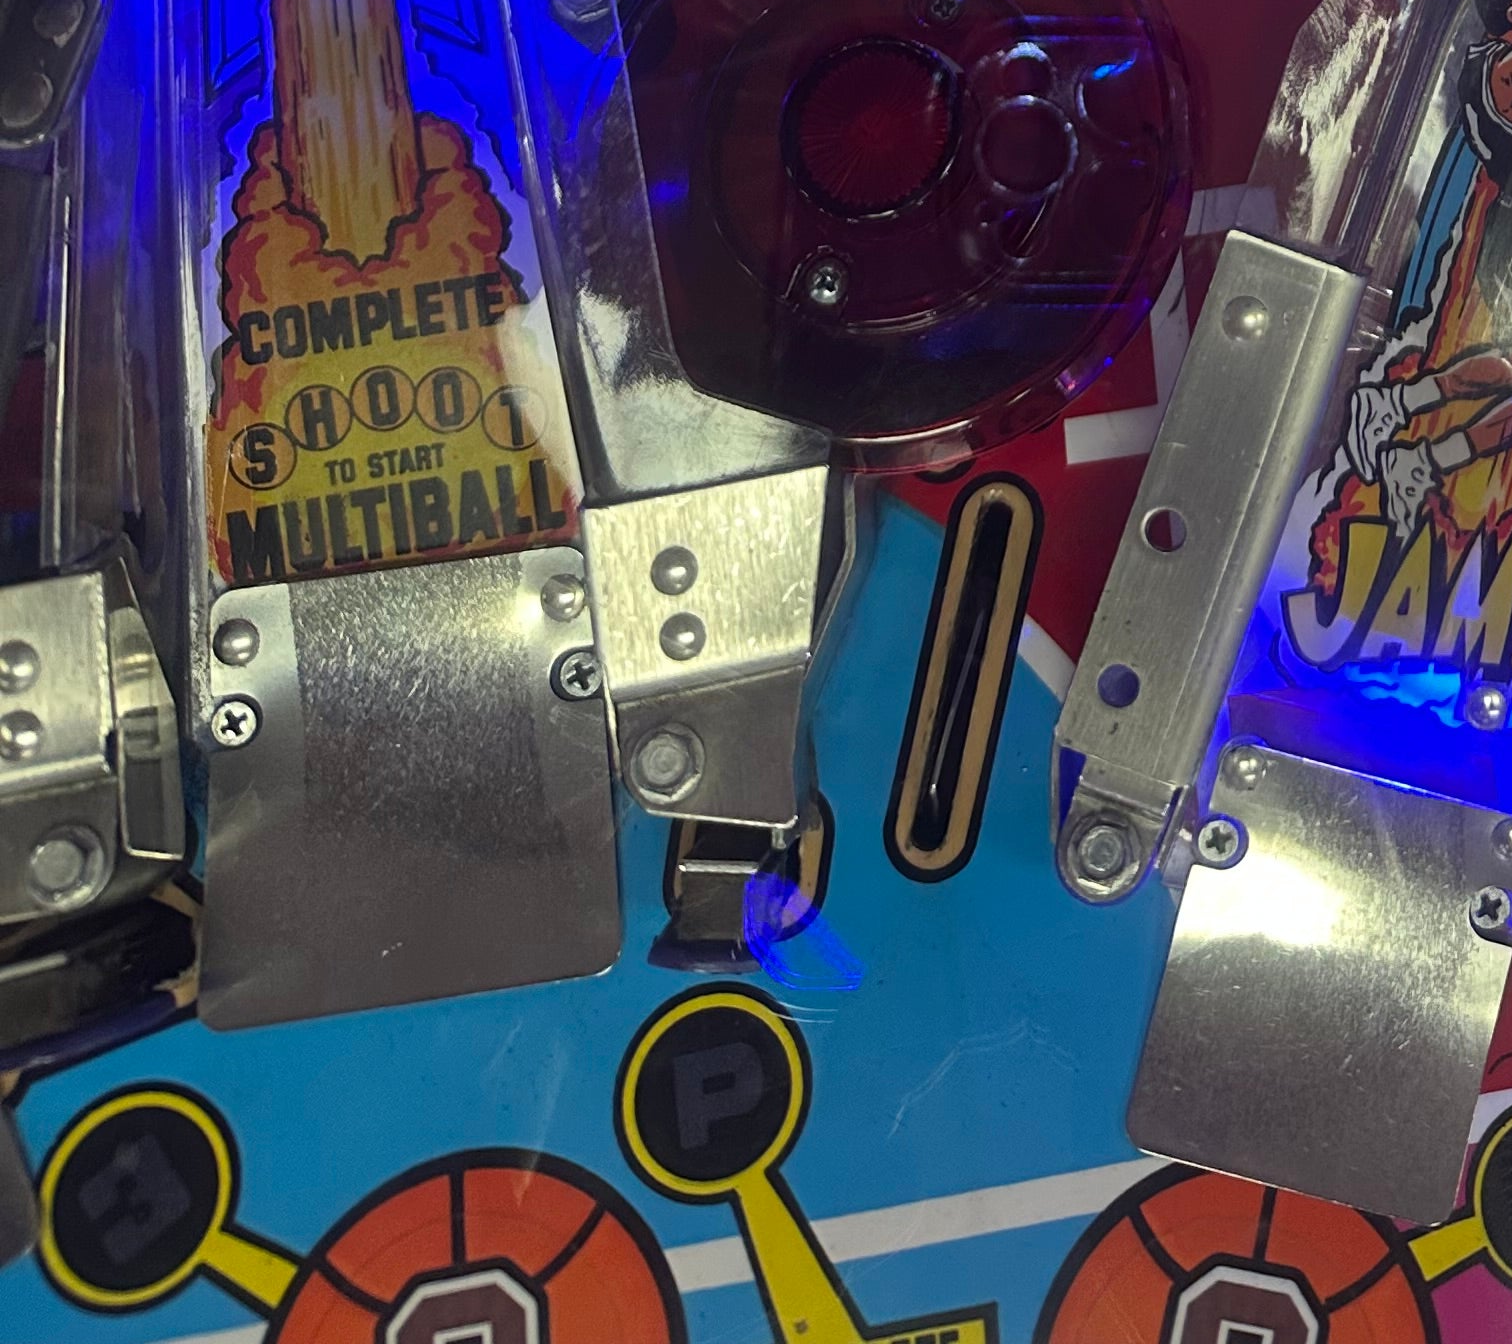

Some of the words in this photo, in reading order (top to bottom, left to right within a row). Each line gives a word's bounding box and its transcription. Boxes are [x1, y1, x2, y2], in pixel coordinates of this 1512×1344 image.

[238, 275, 507, 365] COMPLETE
[324, 458, 356, 487] TO
[369, 443, 446, 480] START
[226, 459, 567, 584] MULTIBALL
